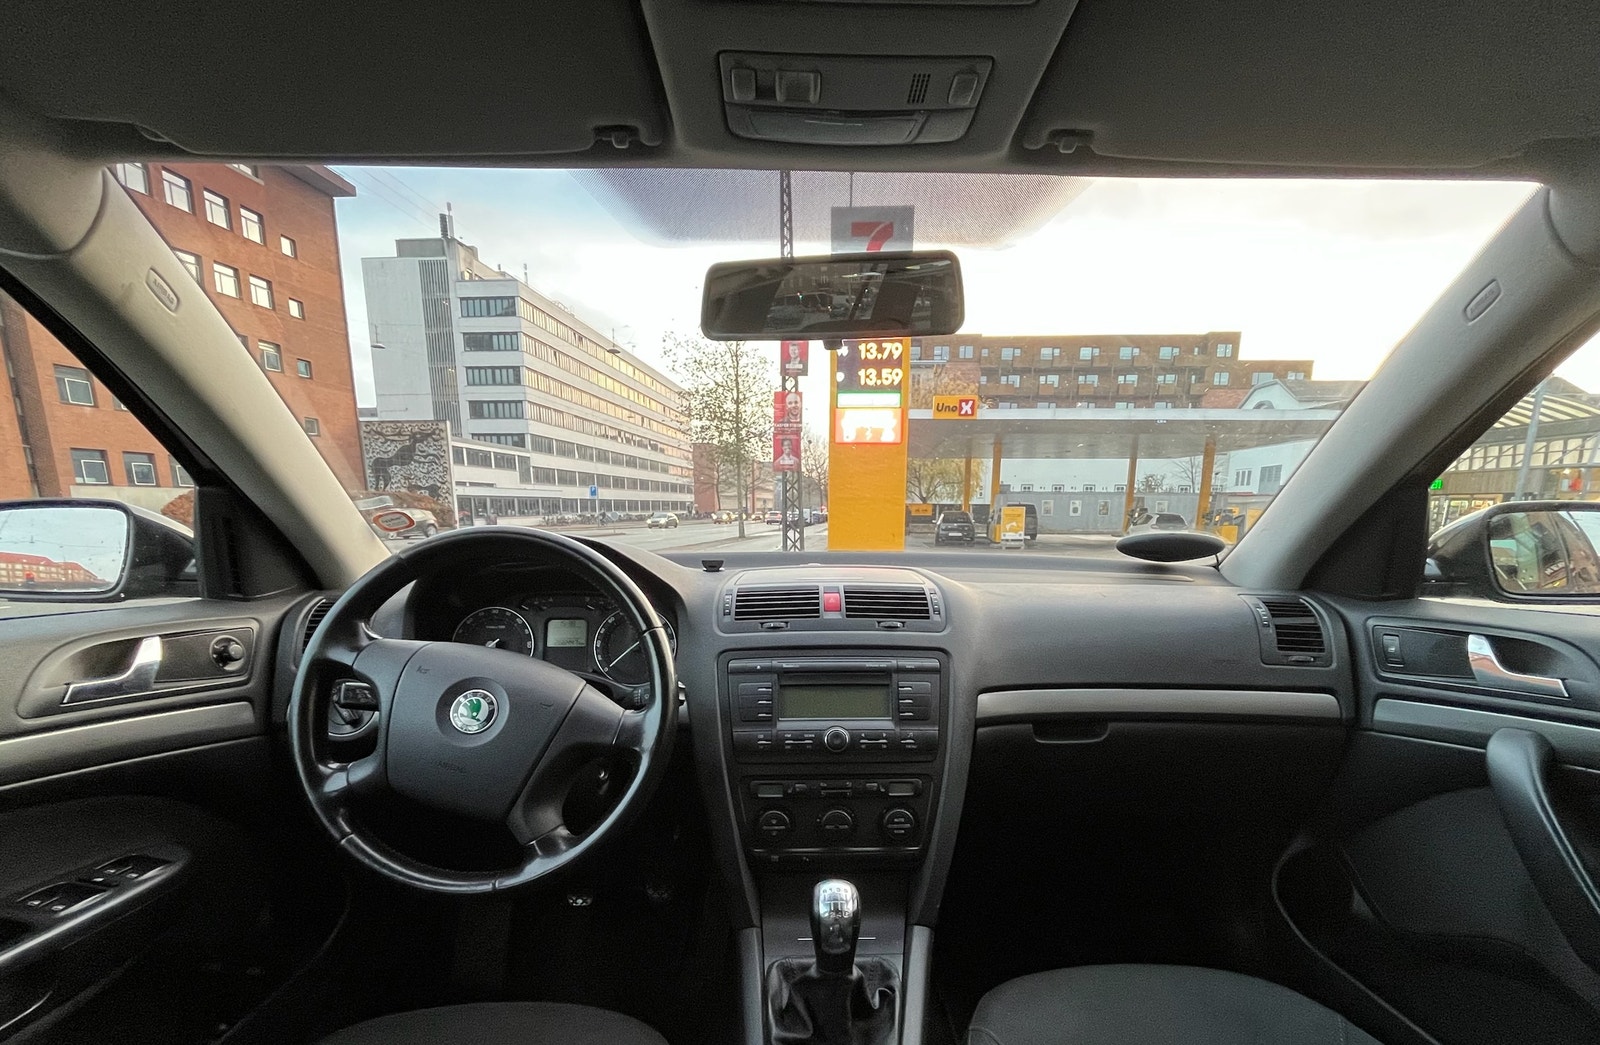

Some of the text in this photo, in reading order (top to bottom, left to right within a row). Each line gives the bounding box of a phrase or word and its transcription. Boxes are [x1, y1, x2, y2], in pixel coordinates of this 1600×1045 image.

[852, 222, 893, 252] 7
[858, 342, 903, 360] 13.79
[858, 367, 904, 386] 13.59
[936, 402, 958, 413] Uno
